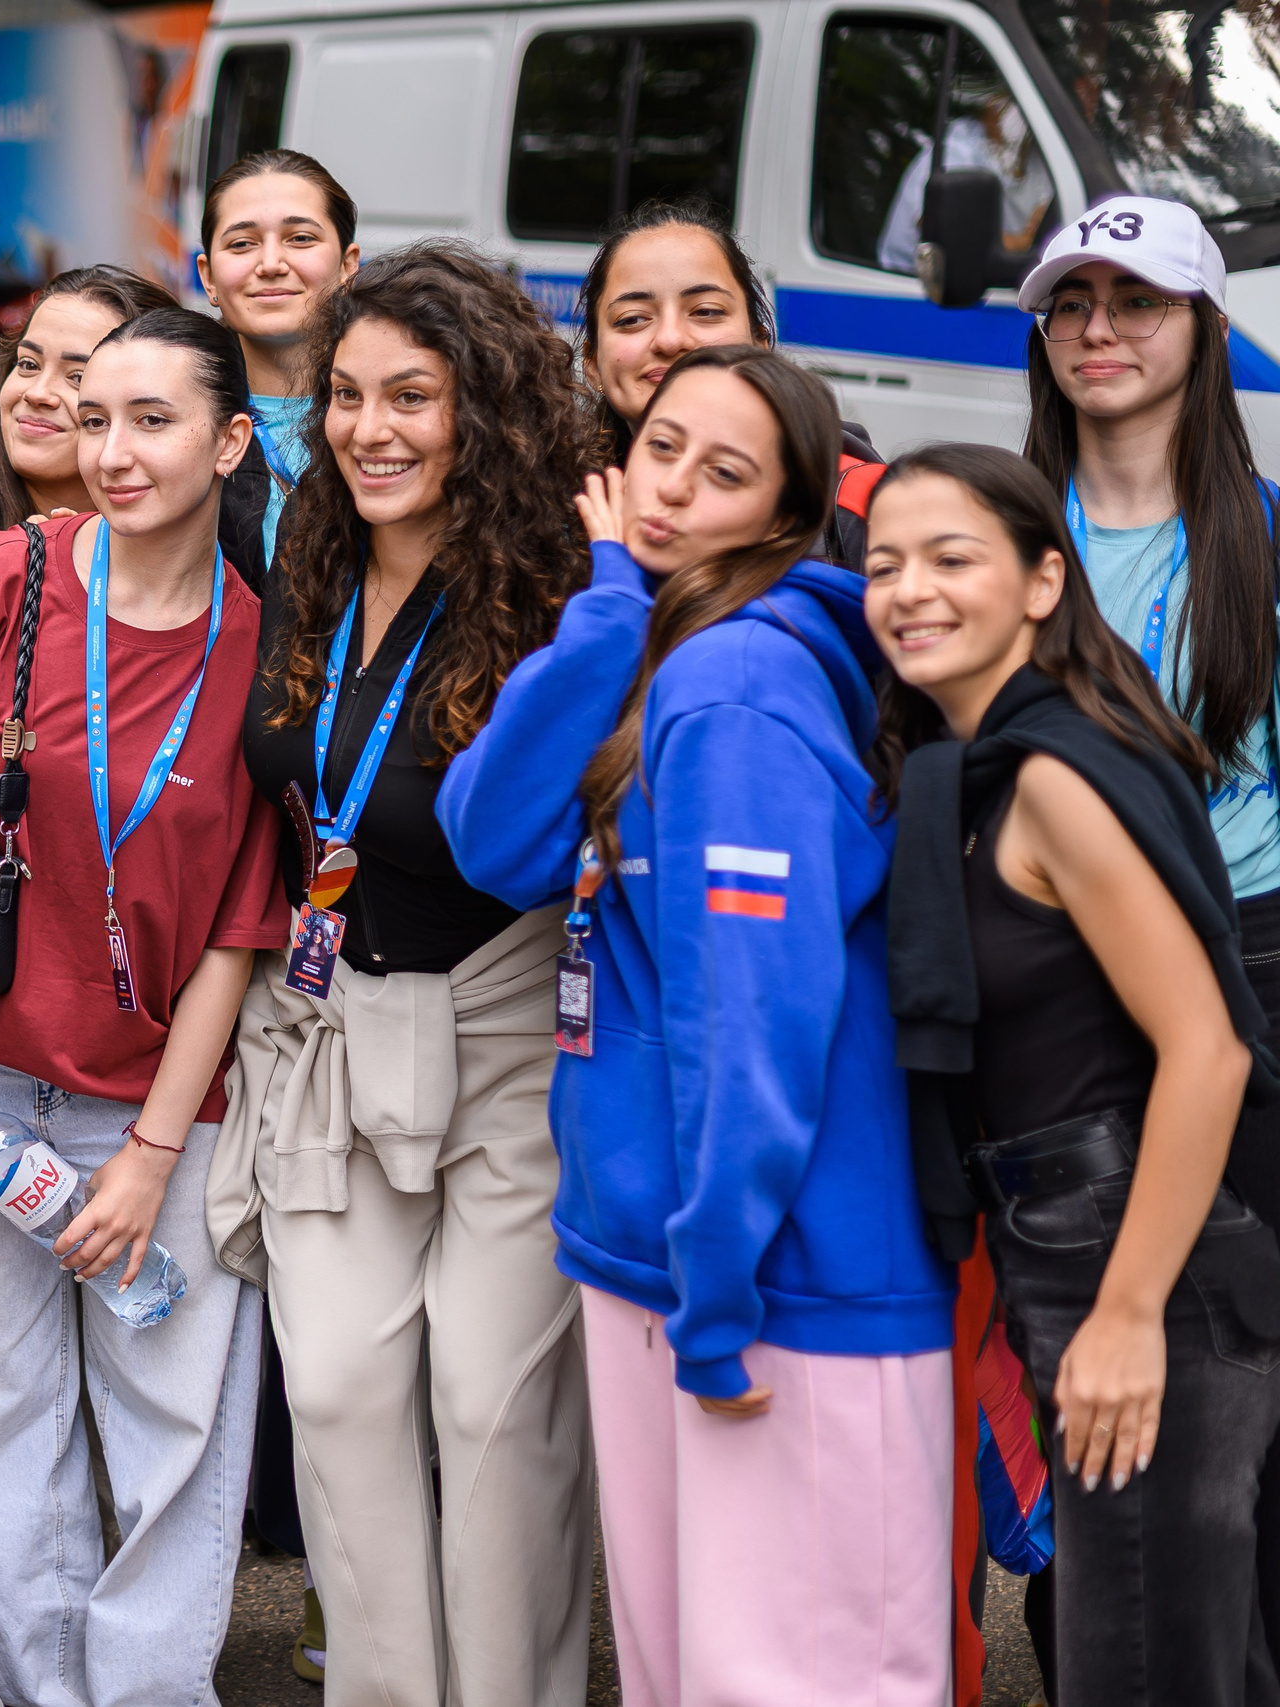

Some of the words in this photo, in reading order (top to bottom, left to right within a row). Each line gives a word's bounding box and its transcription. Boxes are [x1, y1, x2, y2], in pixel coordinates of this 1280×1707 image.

[1078, 211, 1144, 247] Y-3
[168, 771, 194, 788] tner
[5, 1159, 60, 1216] ТБАУ
[25, 1177, 68, 1222] НЕГАЗИРОВАННАЯ
